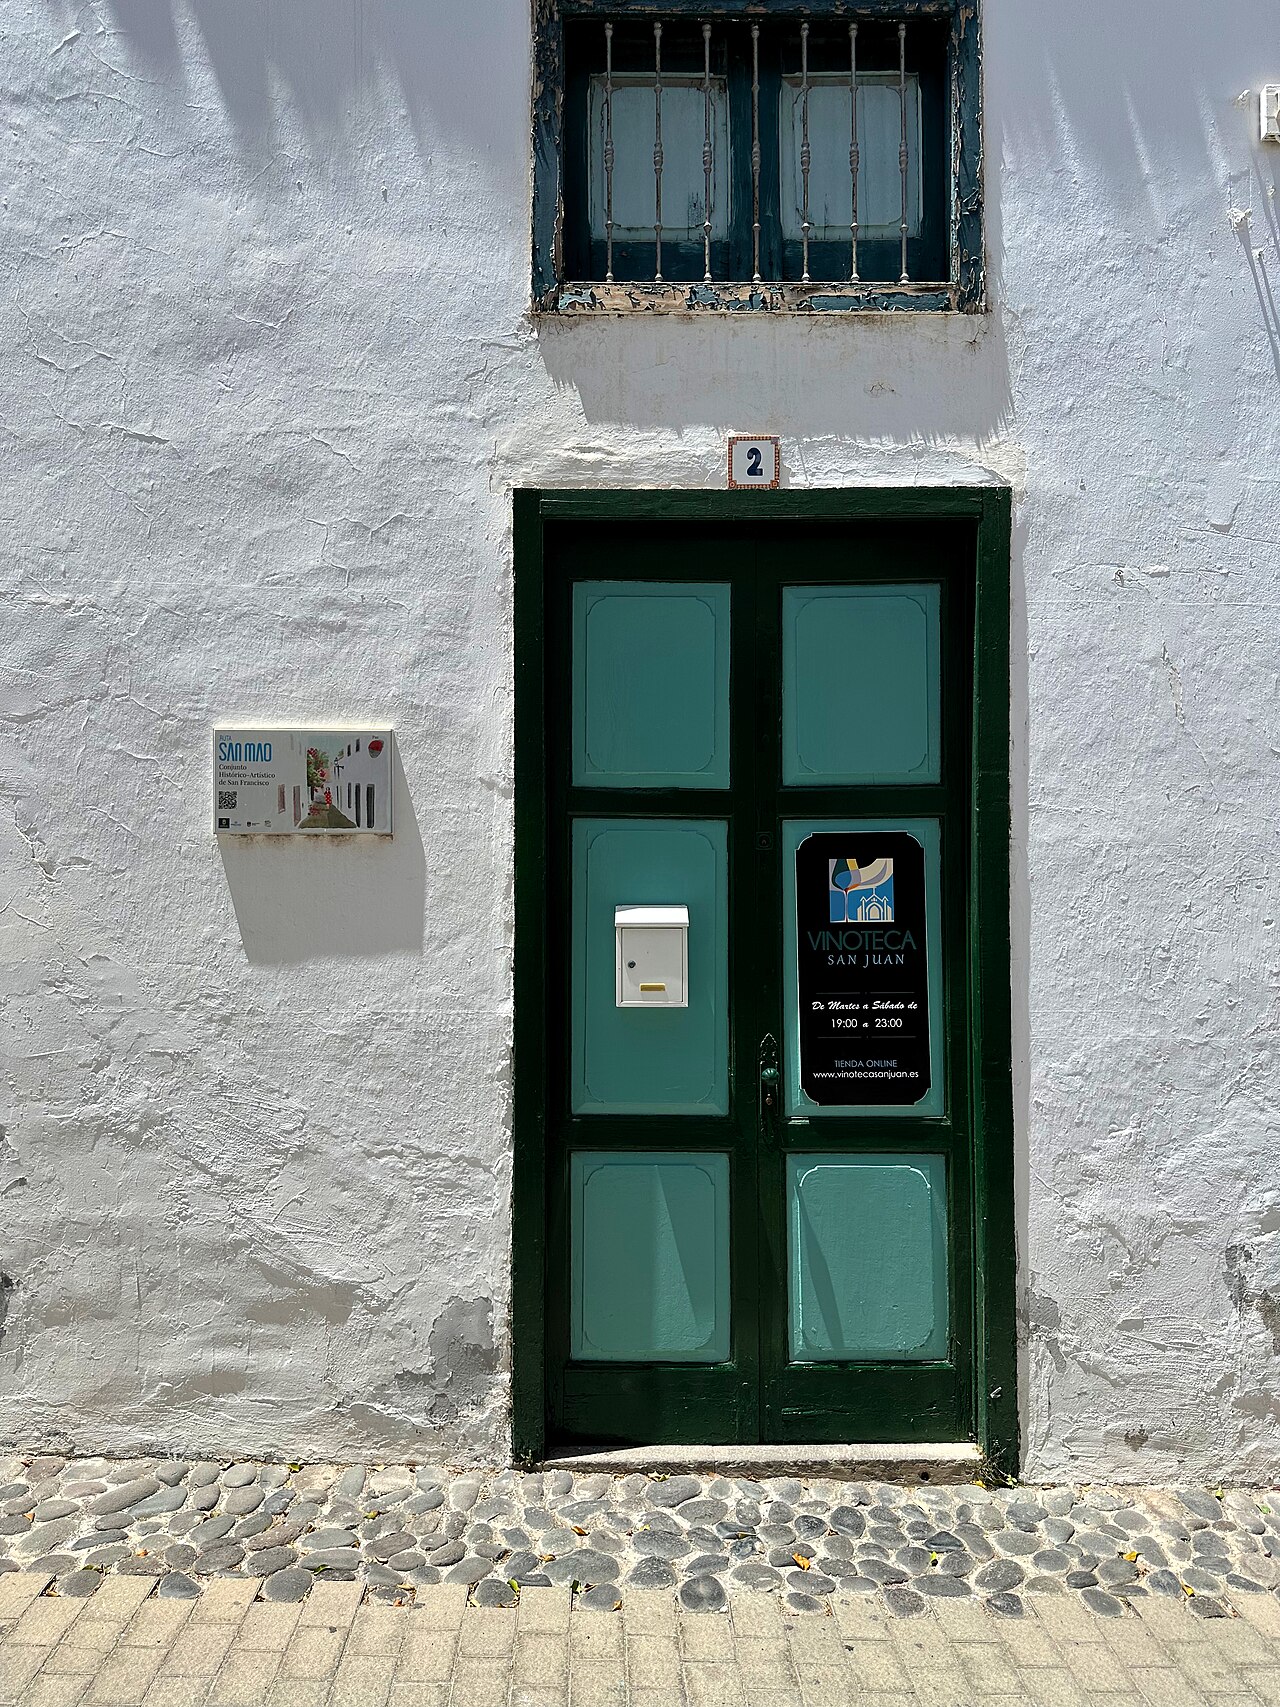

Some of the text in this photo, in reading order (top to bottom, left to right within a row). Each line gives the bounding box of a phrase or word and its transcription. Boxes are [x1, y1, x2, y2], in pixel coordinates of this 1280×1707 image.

[747, 447, 763, 476] 2
[219, 742, 272, 762] SAN MAO
[807, 930, 917, 951] VINOTECA
[828, 954, 905, 968] SAN JUAN
[812, 1001, 825, 1010] De
[828, 1001, 860, 1010] Martes
[872, 1000, 905, 1010] Sábado
[907, 1001, 918, 1010] de
[832, 1018, 858, 1028] 19:00
[875, 1018, 903, 1028] 23:00
[834, 1060, 898, 1068] TIENDA ONLINE
[813, 1070, 919, 1080] www.vinotecasanjuan.es
